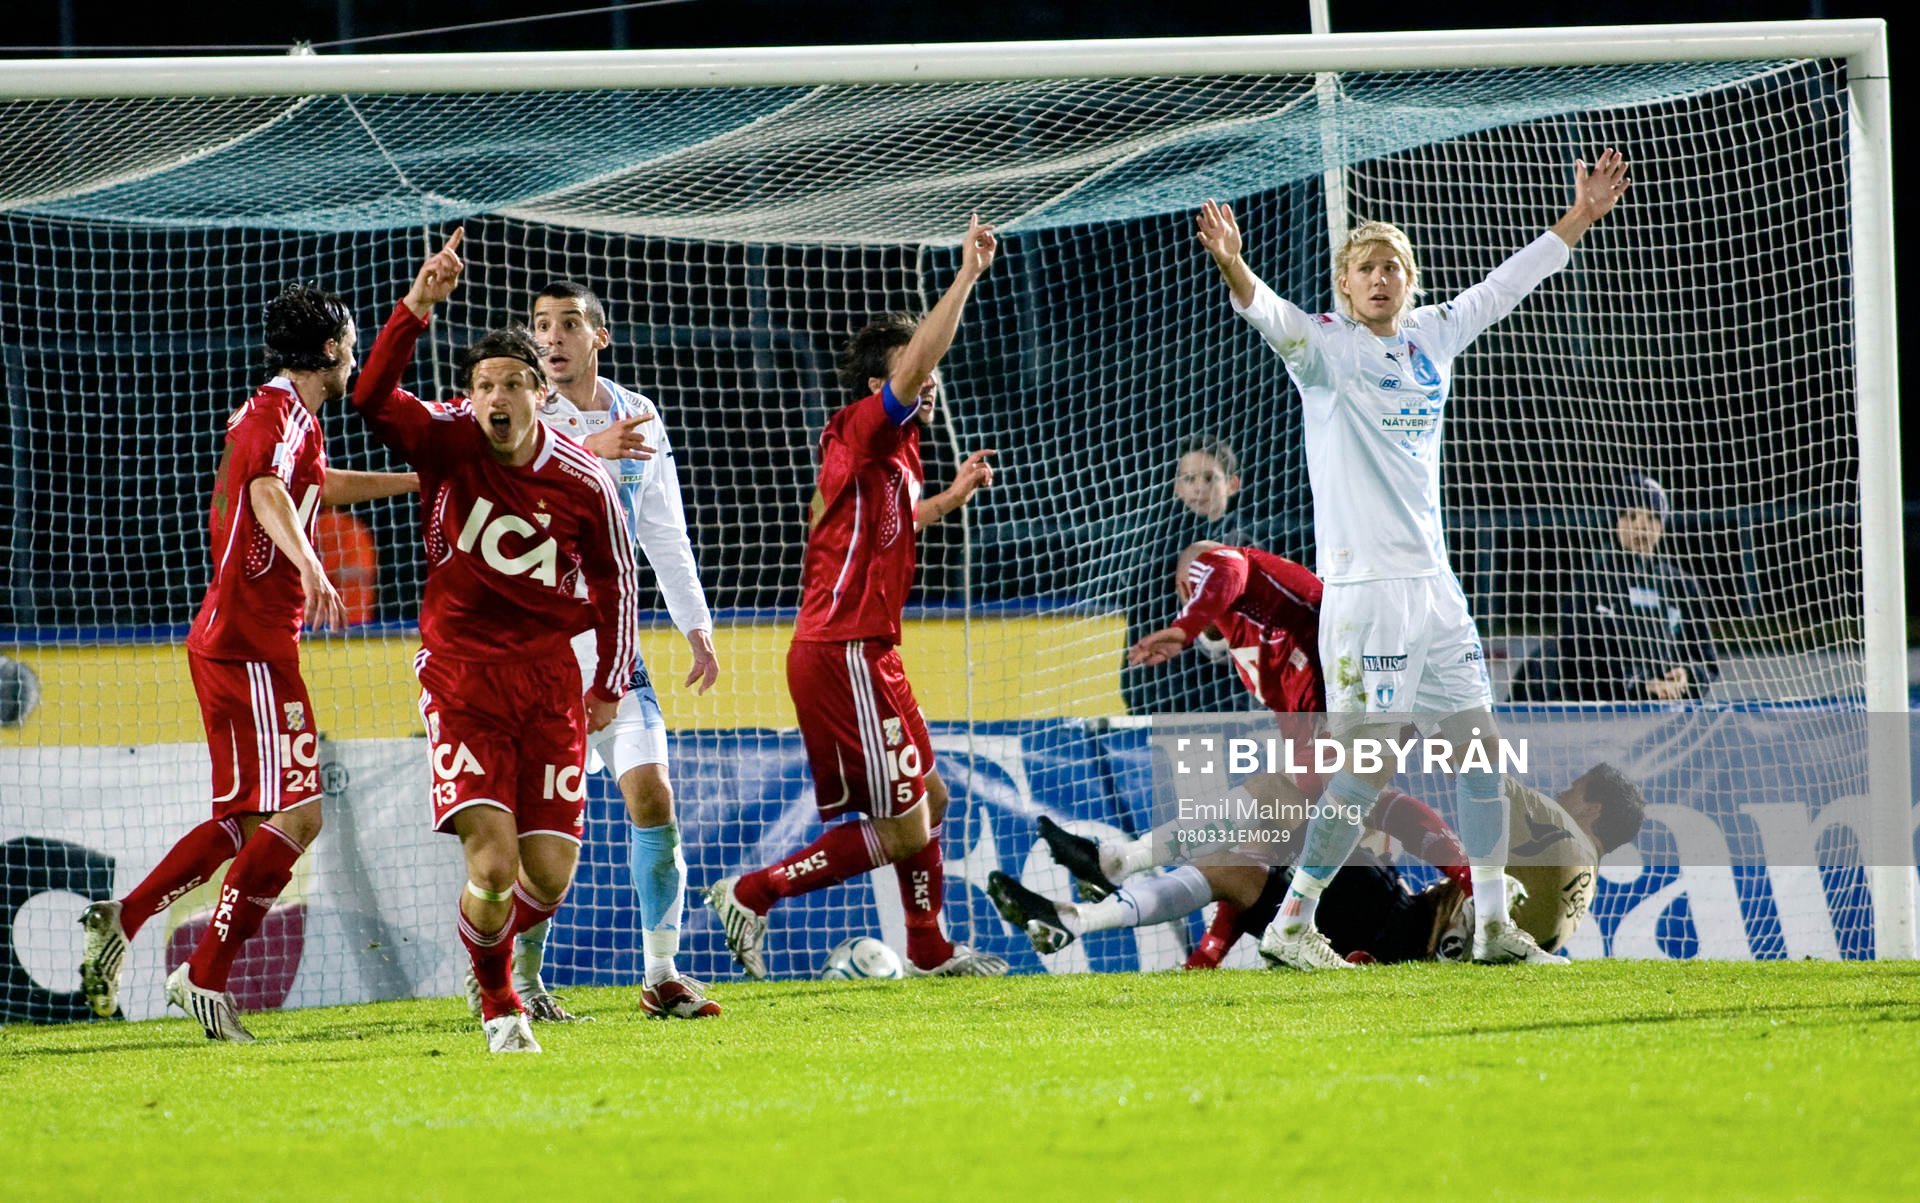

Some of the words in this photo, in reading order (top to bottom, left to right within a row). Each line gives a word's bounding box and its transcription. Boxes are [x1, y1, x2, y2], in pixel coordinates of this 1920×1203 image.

[1382, 378, 1399, 389] BE
[558, 461, 583, 480] TEAM
[456, 496, 558, 588] ICA
[280, 732, 320, 769] IC
[433, 741, 486, 781] CA
[885, 744, 922, 781] IC
[286, 769, 318, 792] 24
[433, 781, 458, 807] 13
[897, 782, 913, 803] 5
[785, 850, 829, 880] SKF
[912, 870, 932, 912] SKF
[214, 884, 240, 943] SKF
